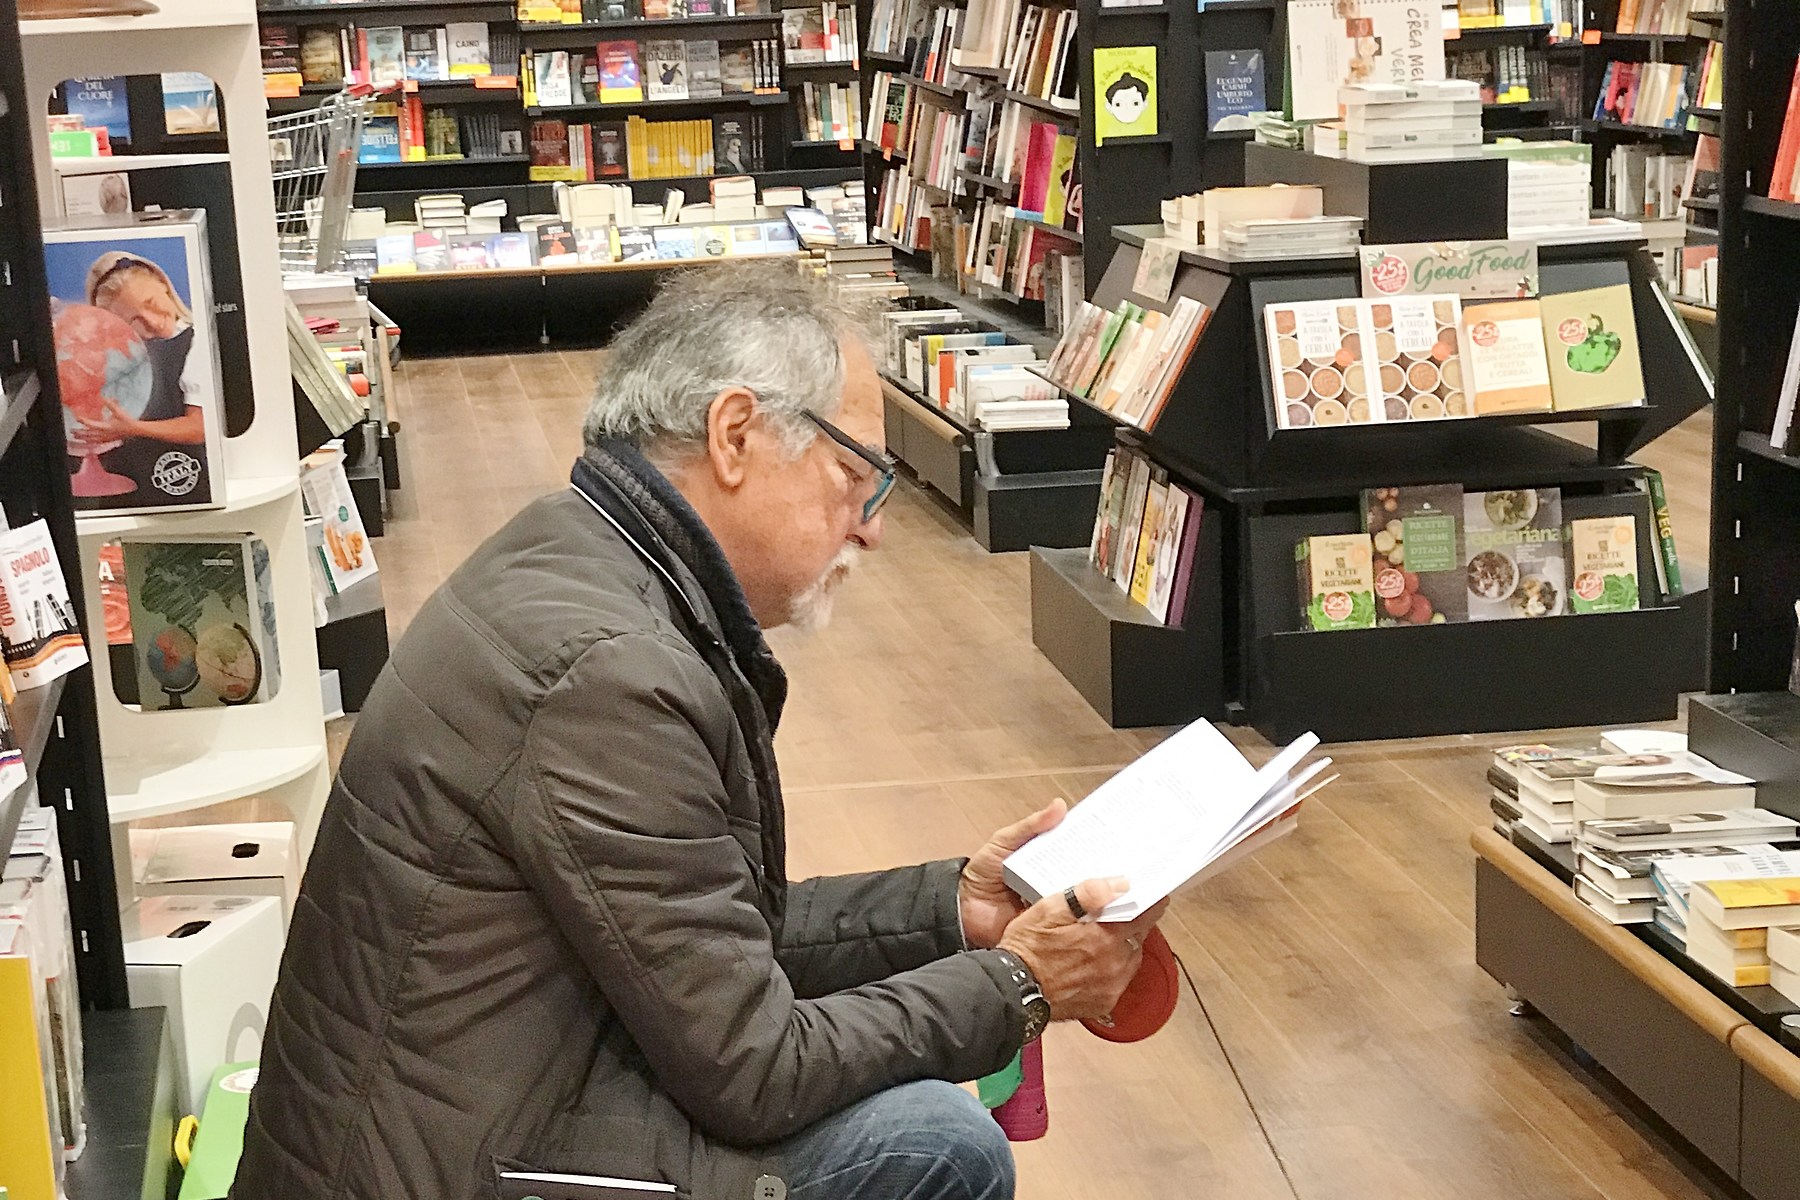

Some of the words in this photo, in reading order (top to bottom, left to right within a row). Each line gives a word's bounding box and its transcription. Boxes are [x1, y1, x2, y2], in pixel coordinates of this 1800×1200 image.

[1407, 8, 1422, 48] CREA
[1391, 48, 1406, 84] VER
[1408, 54, 1424, 82] ME
[77, 90, 114, 101] CUORE
[85, 81, 104, 91] DEL
[1414, 257, 1474, 292] Good
[1469, 245, 1531, 274] Food
[159, 463, 193, 485] ITALY
[10, 547, 51, 578] SPAGNOLO
